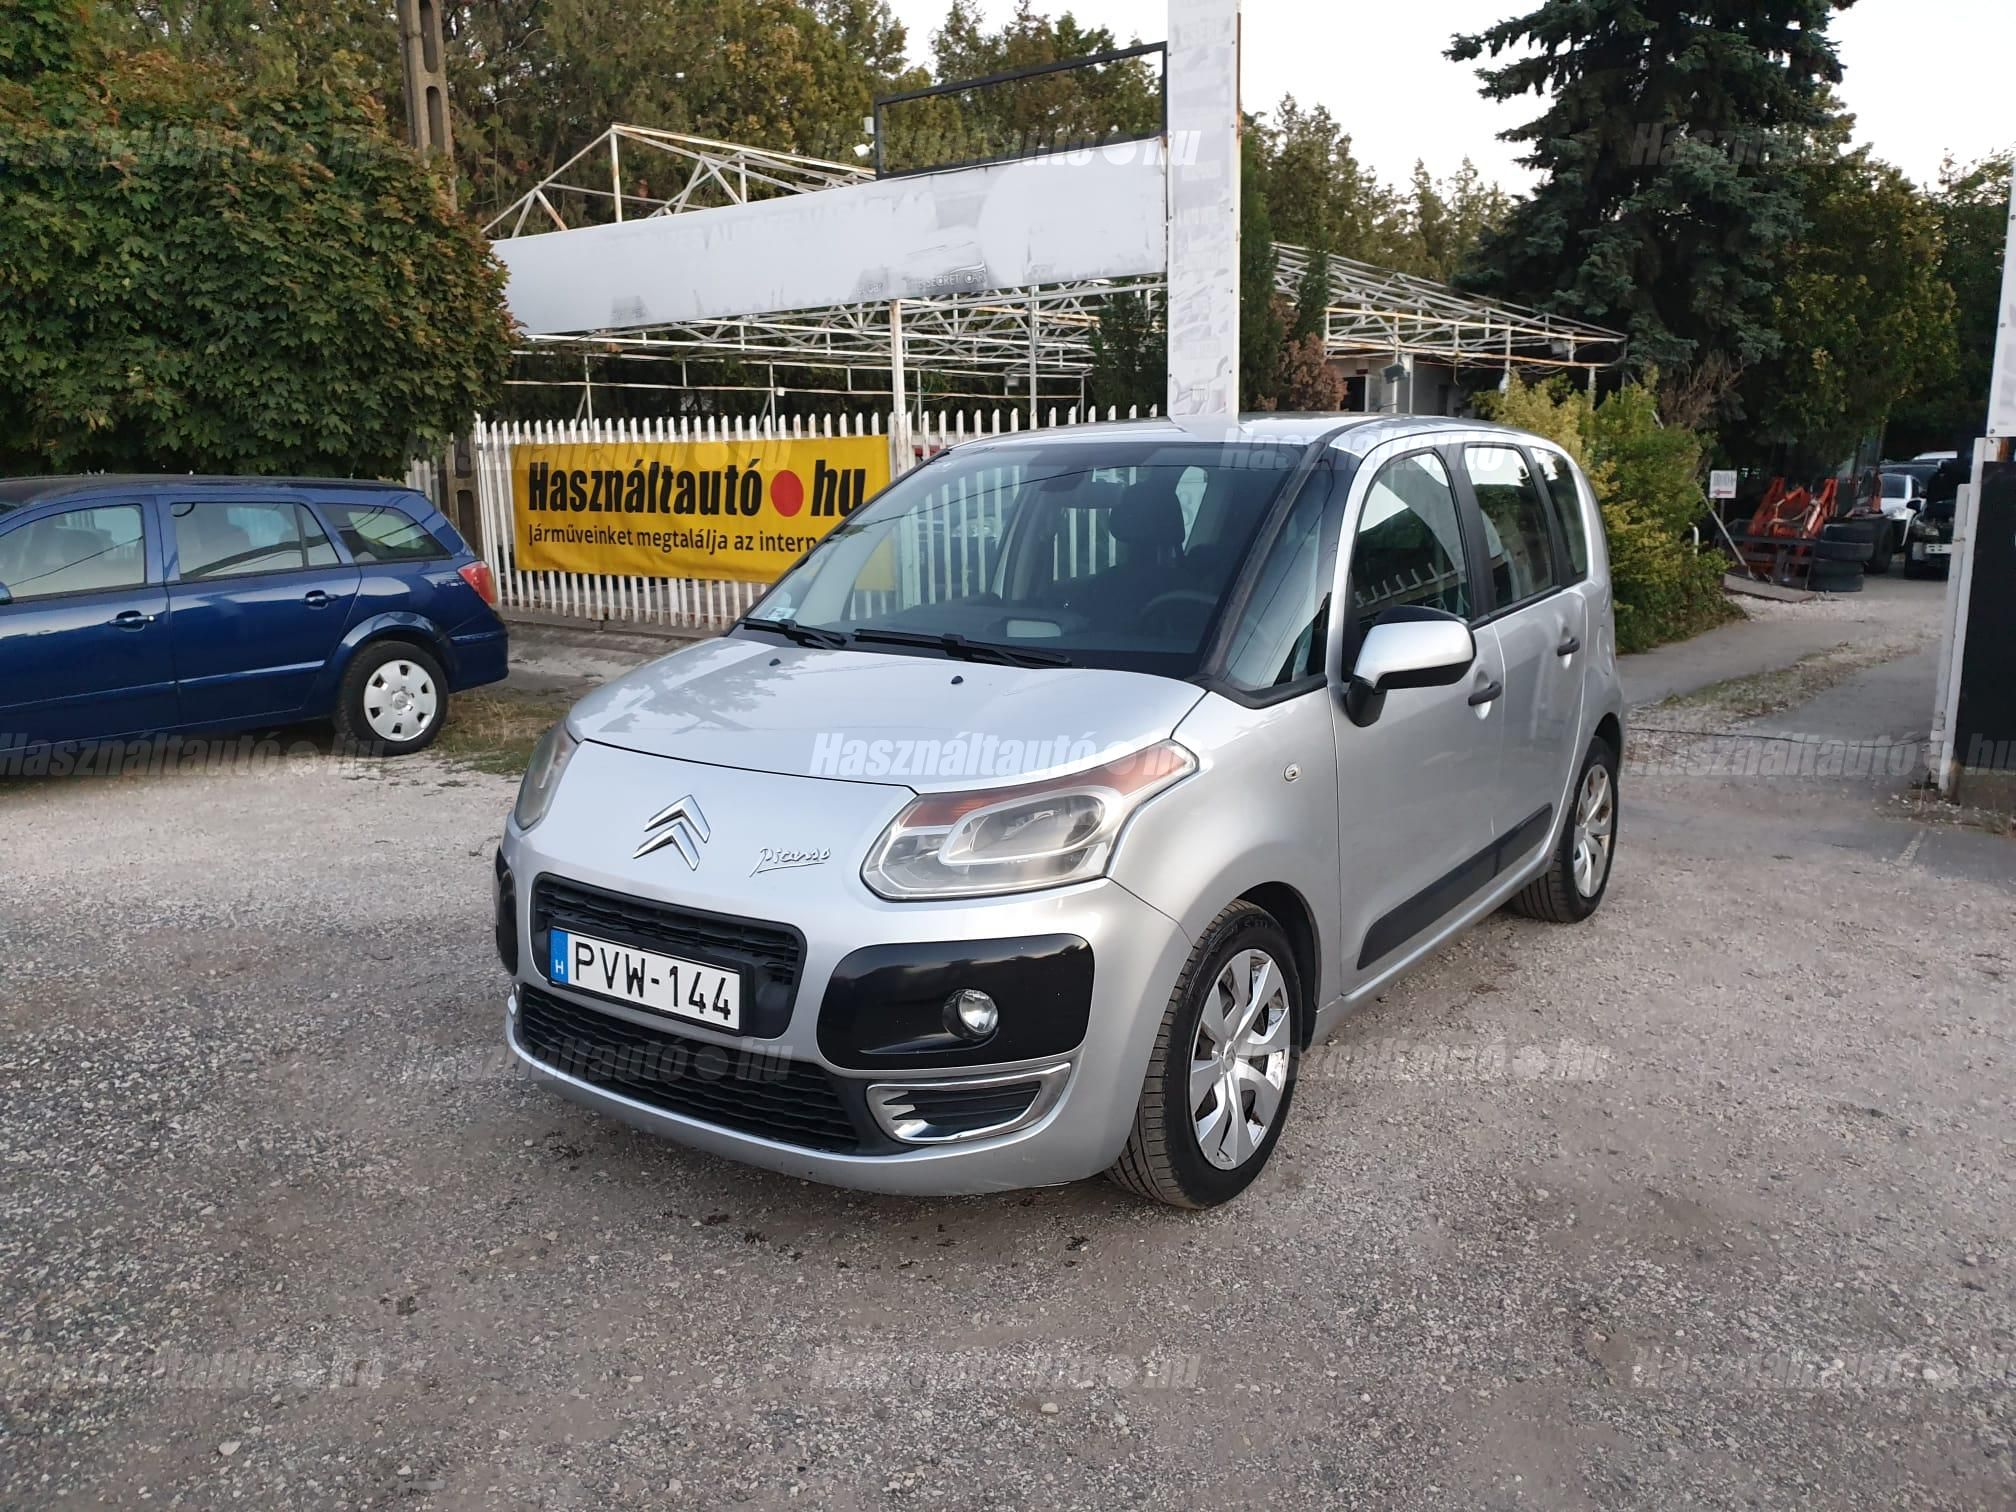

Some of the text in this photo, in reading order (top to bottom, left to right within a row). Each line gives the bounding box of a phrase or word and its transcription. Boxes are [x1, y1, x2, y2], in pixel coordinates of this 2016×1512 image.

[528, 458, 867, 517] Használtautó hu
[528, 523, 633, 547] Járműveinket
[637, 528, 728, 555] megtalálja
[735, 534, 754, 551] az
[748, 847, 831, 879] Picasso
[555, 959, 564, 975] H
[575, 941, 731, 1021] PVW-144
